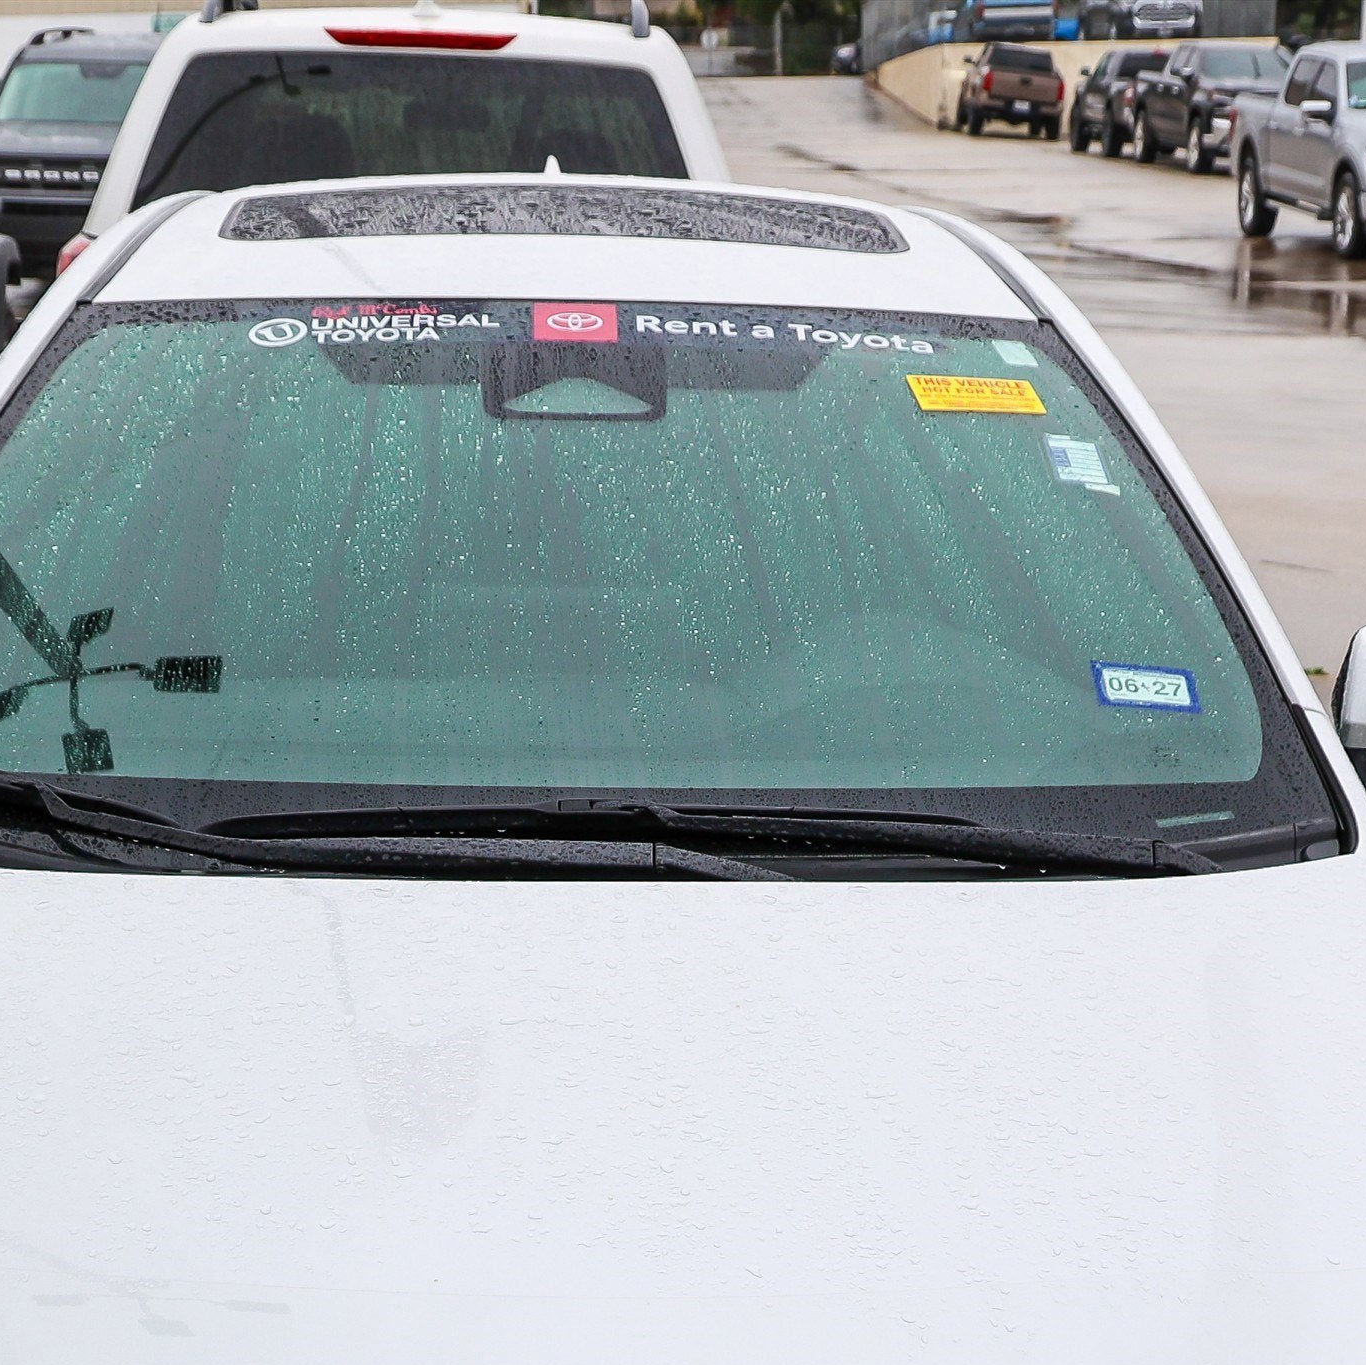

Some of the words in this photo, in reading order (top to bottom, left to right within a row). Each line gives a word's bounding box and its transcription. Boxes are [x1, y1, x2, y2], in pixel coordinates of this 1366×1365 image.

[312, 314, 500, 330] UNIVERSAL
[312, 328, 441, 344] TOYOTA
[635, 314, 738, 338] Rent
[751, 322, 776, 339] a
[788, 322, 936, 355] Toyota
[914, 376, 952, 387] THIS
[954, 378, 1025, 390] VEHICLE
[922, 386, 951, 394] NOT
[989, 388, 1027, 397] SALE
